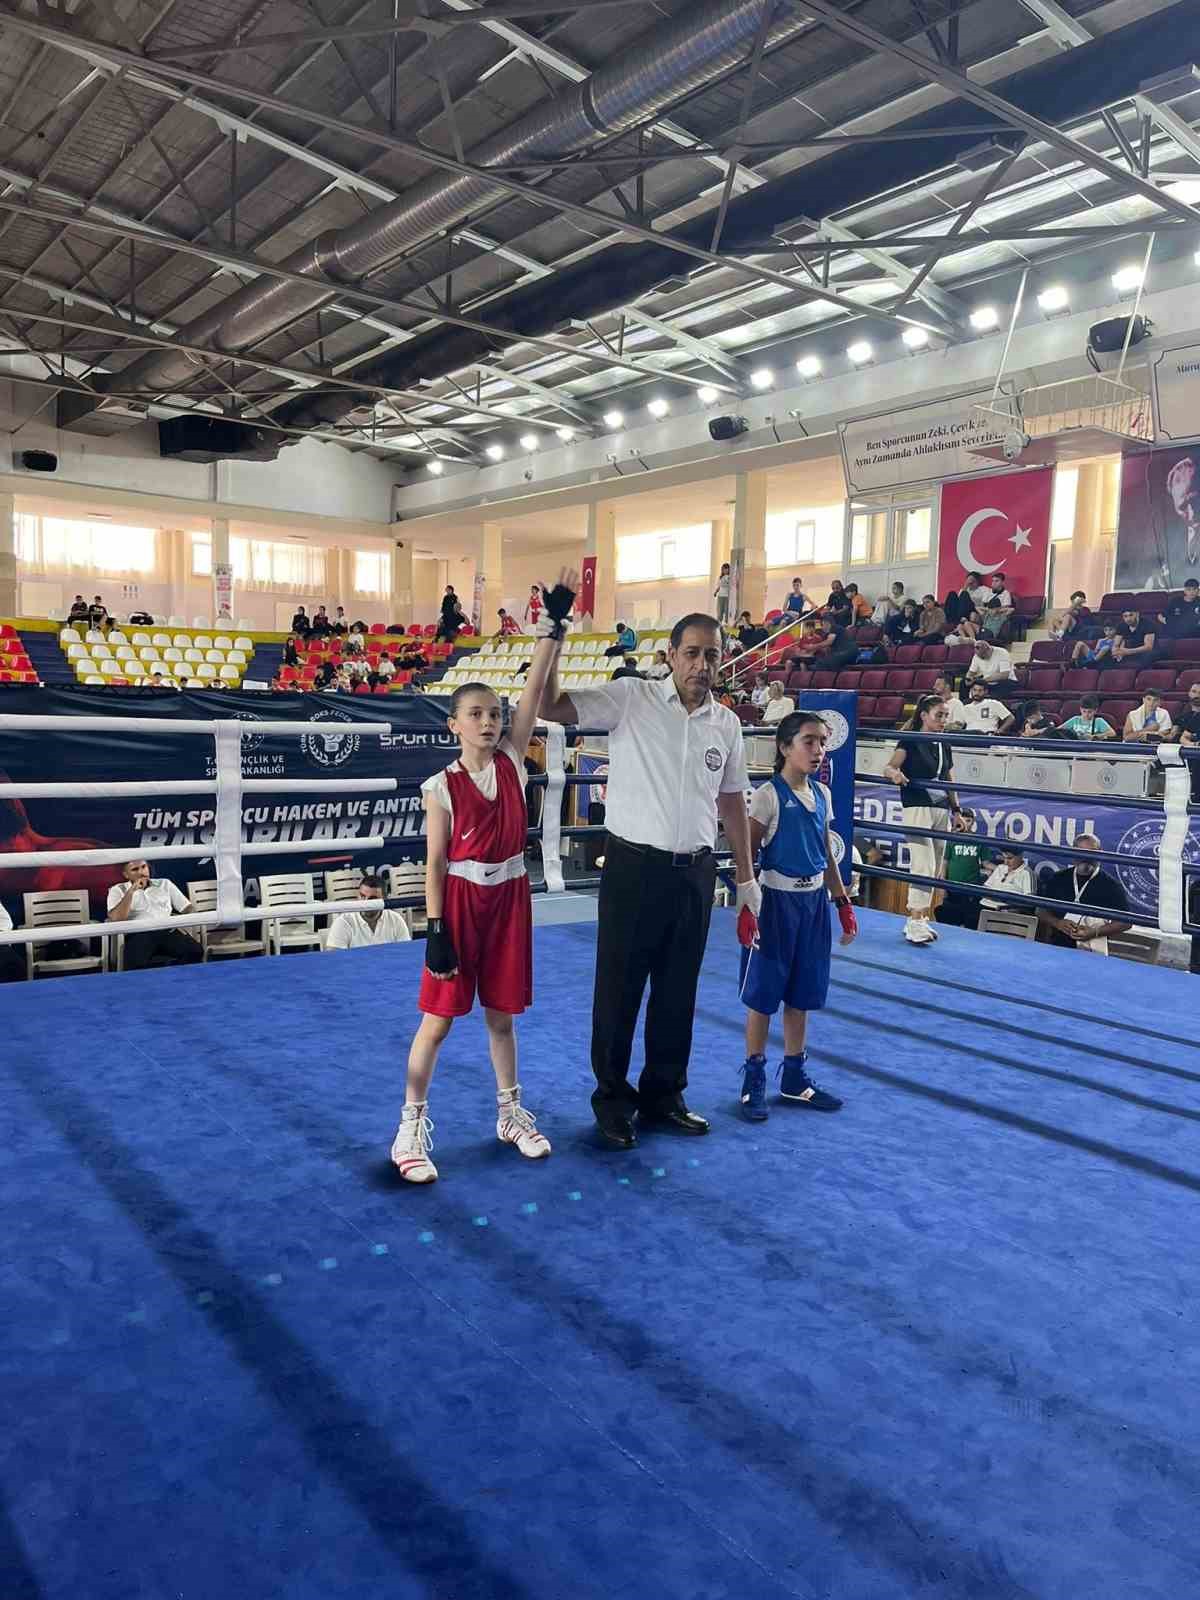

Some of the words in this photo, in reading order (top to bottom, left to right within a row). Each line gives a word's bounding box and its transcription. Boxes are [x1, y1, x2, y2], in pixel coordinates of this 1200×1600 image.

[866, 441, 882, 451] Ben
[882, 432, 927, 449] Sporcunun
[854, 455, 872, 468] Aynı
[872, 448, 912, 464] Zamanda
[272, 755, 285, 764] VE
[240, 765, 285, 776] AKANLIĞI
[133, 808, 182, 830] TÜM
[186, 806, 269, 828] SPCU
[273, 802, 342, 822] HAKEM
[347, 799, 370, 817] VE
